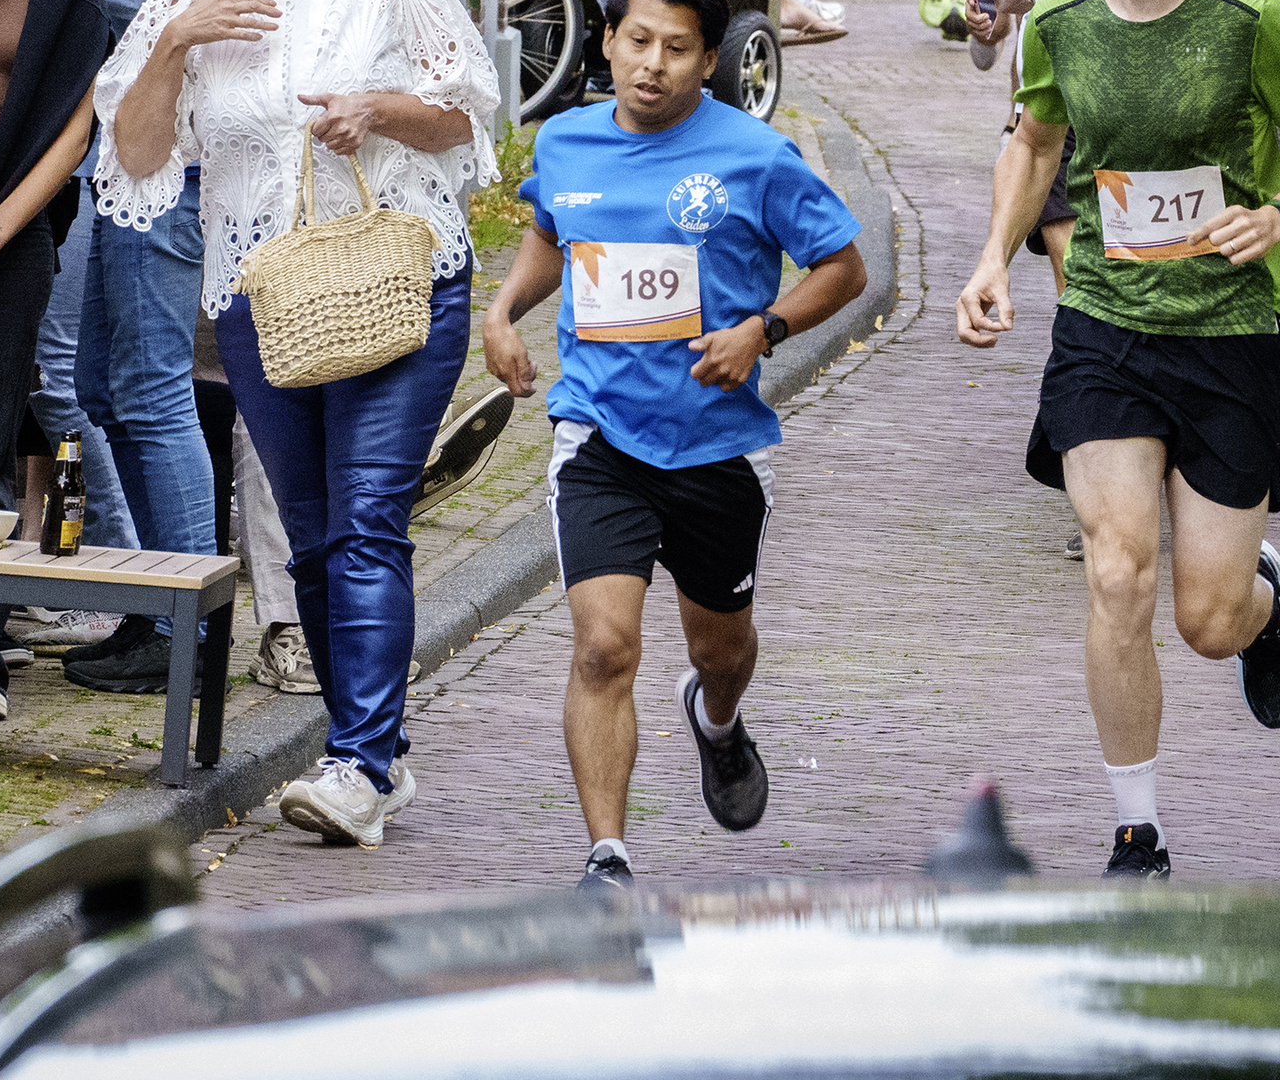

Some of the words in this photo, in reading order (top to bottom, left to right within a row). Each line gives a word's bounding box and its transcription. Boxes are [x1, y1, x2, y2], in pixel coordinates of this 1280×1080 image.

[672, 175, 726, 205] CURRIMUS
[1148, 189, 1205, 223] 217
[678, 216, 710, 231] Leiden
[621, 268, 679, 300] 189
